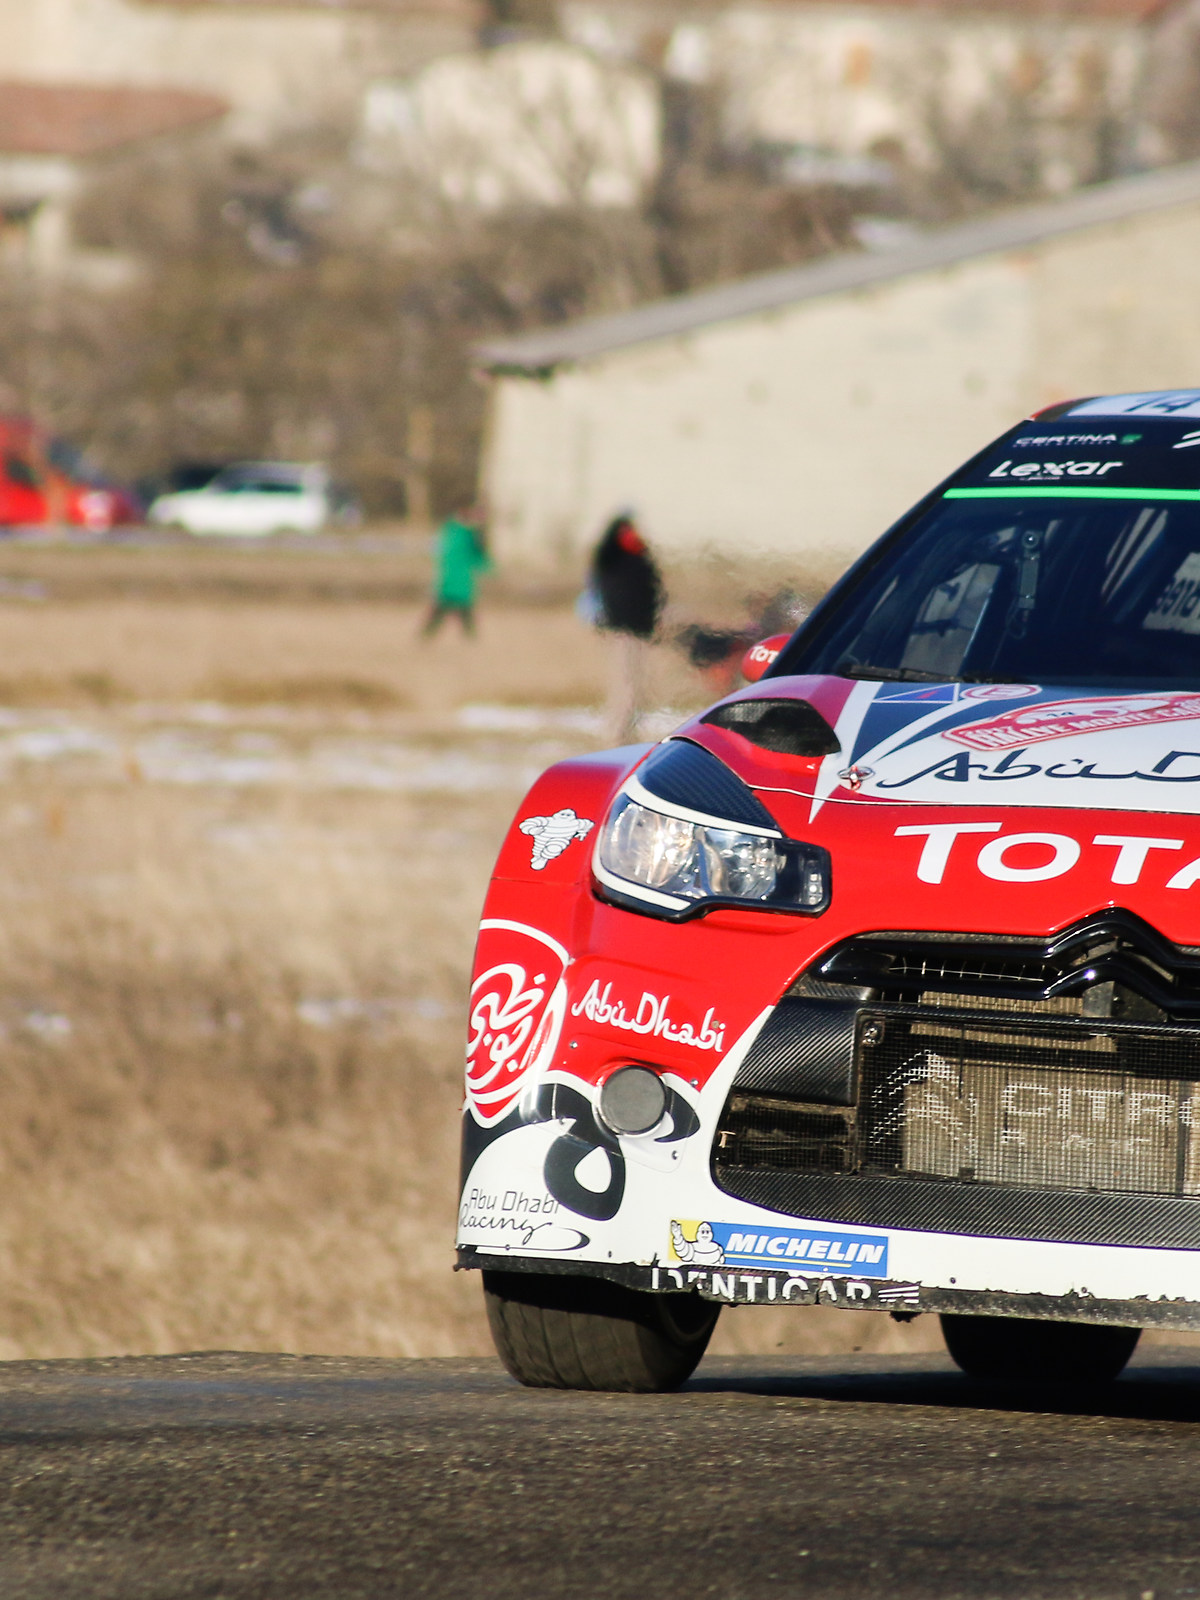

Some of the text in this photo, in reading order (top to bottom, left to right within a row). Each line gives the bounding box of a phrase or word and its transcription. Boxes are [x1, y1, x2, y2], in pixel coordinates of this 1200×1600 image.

[1014, 434, 1118, 446] CERTINA
[988, 458, 1125, 478] Lexar
[749, 645, 779, 665] TOT
[628, 991, 727, 1053] Dhabi
[469, 1188, 560, 1214] Abu Dhabi
[460, 1203, 553, 1246] Racing
[725, 1232, 885, 1264] MICHELIN
